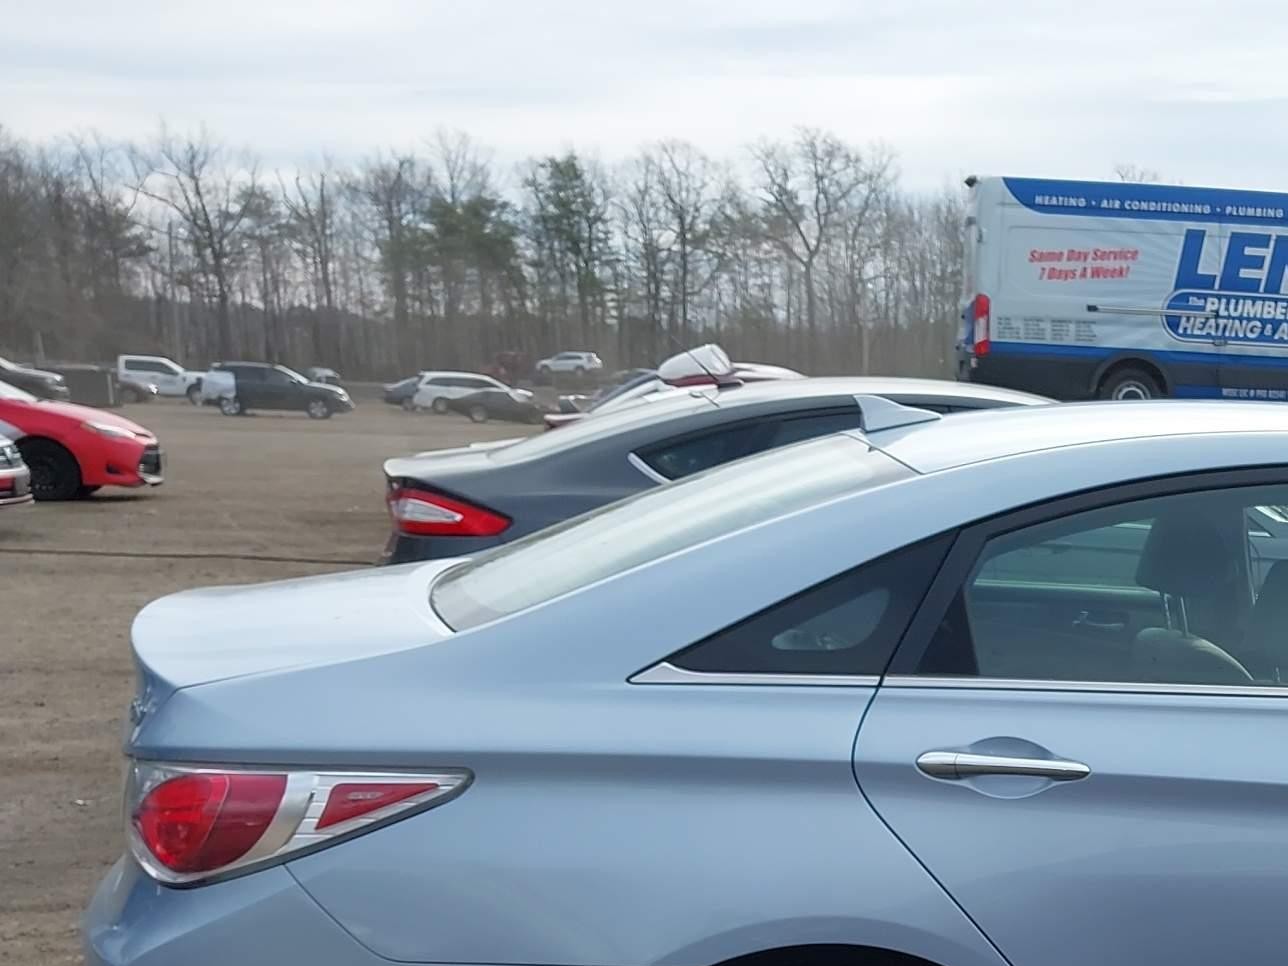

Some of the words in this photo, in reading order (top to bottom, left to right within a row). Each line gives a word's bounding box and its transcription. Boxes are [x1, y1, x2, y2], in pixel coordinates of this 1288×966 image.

[1034, 195, 1087, 208] HEATING
[1101, 198, 1122, 210] AIR
[1124, 200, 1212, 215] CONDITIONING
[1225, 205, 1284, 218] PLUMBING
[1029, 249, 1064, 263] Same
[1066, 249, 1090, 263] Day
[1091, 249, 1139, 262] Service
[1047, 266, 1077, 281] Days
[1079, 266, 1088, 279] A
[1090, 265, 1131, 280] Week!
[1178, 316, 1262, 338] HEATING
[1264, 323, 1275, 336] &
